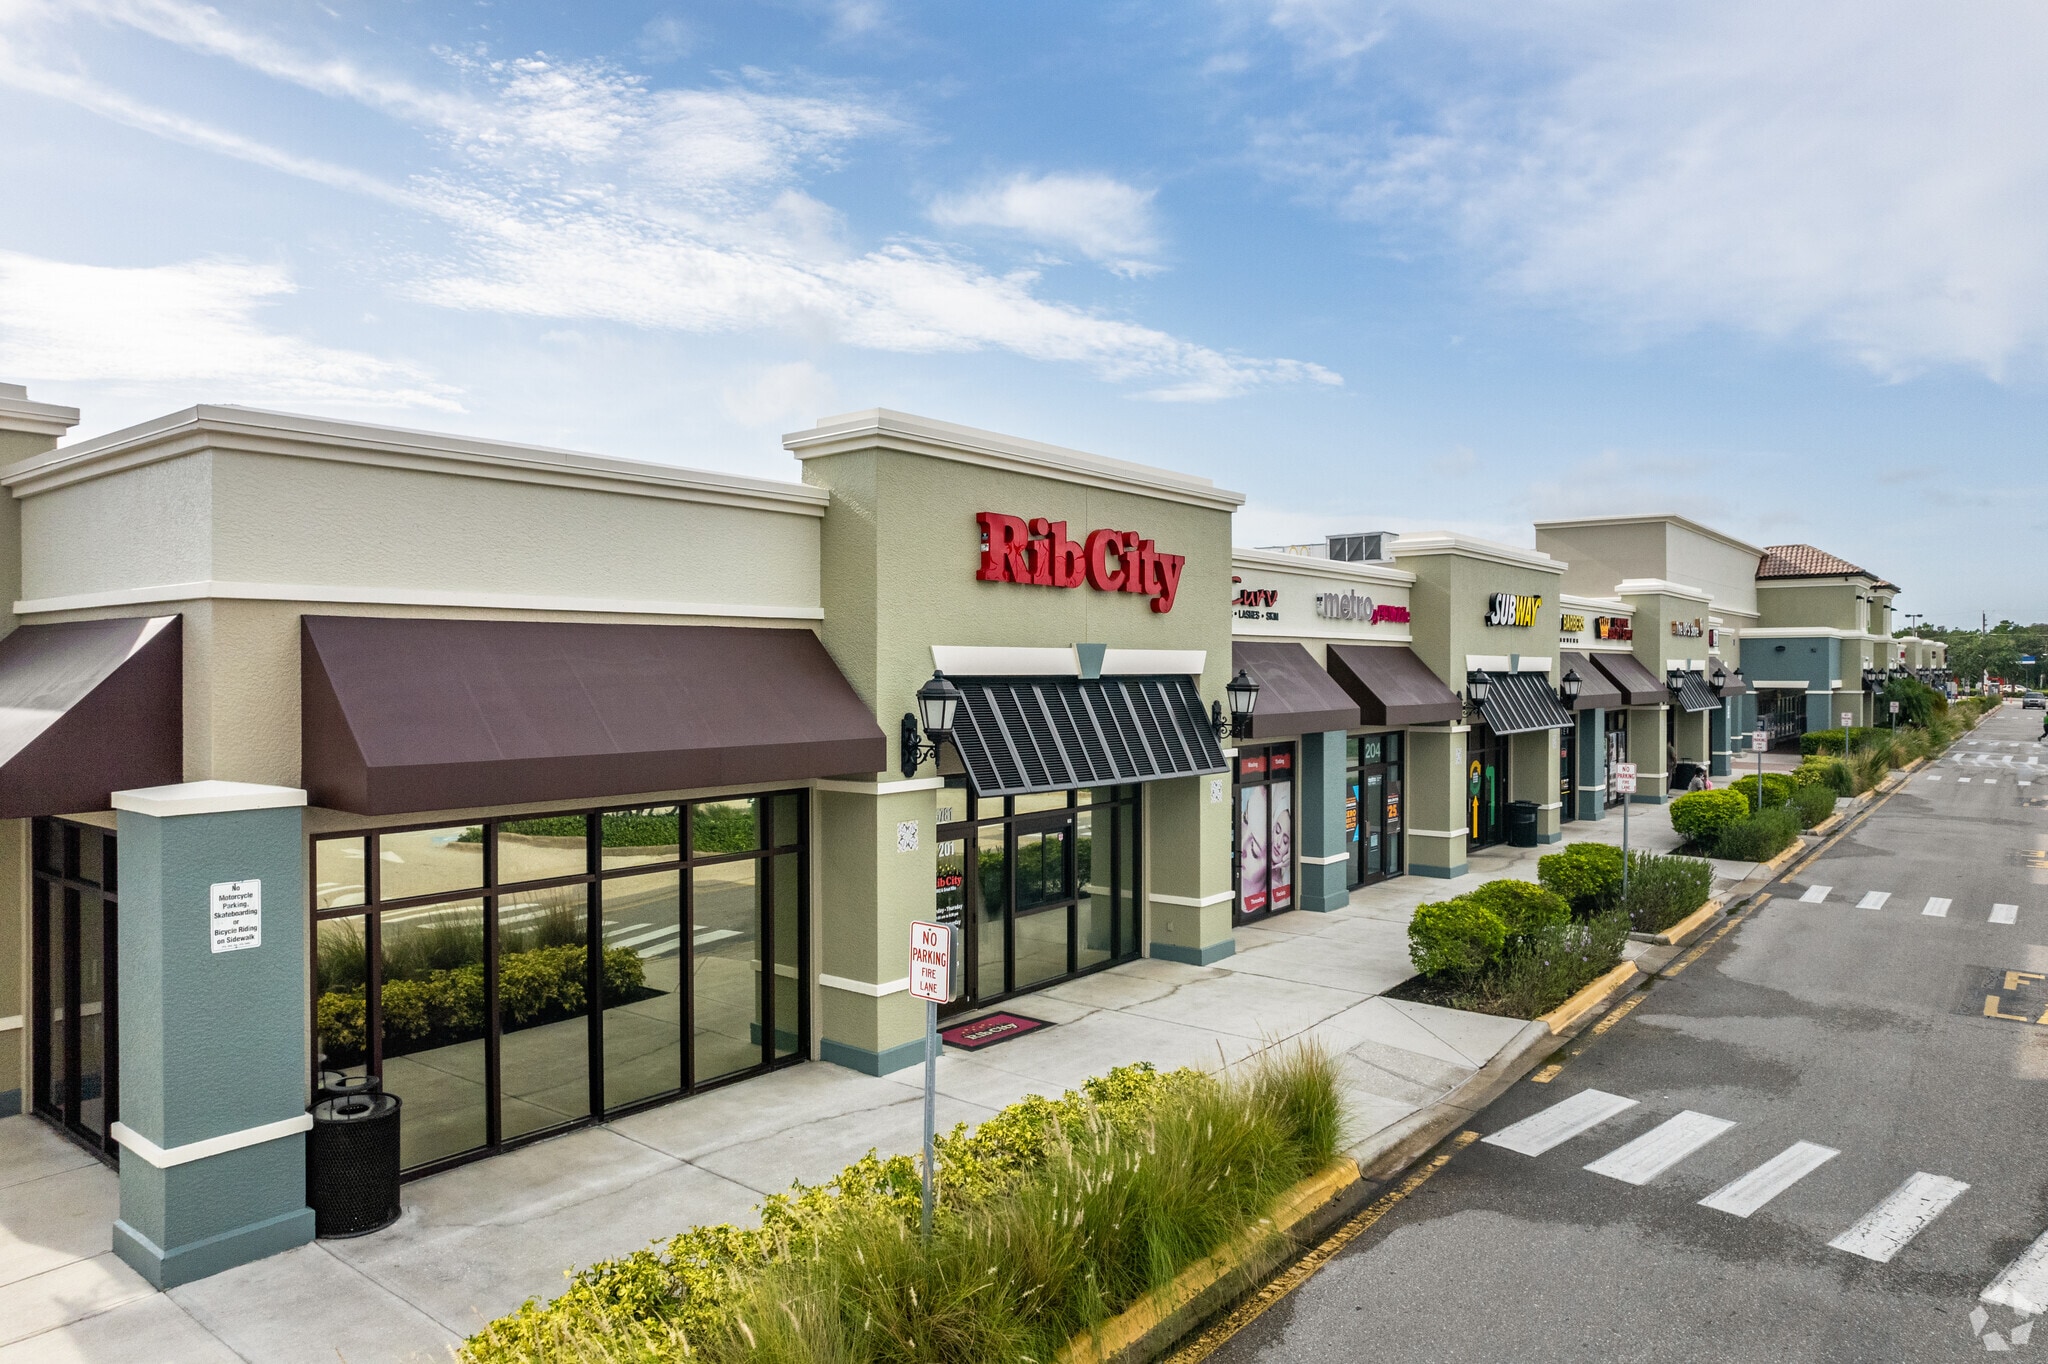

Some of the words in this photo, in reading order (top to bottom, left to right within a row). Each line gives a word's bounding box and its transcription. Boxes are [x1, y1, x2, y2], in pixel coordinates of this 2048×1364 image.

[1323, 589, 1373, 621] metro
[1487, 592, 1542, 627] SUBWAY
[1238, 610, 1260, 619] LASHES
[1365, 742, 1381, 759] 204
[938, 841, 955, 857] 201
[219, 892, 253, 902] Motorcycle
[214, 909, 258, 919] Skateboarding
[214, 927, 238, 936] Bicycle
[238, 925, 258, 934] Riding
[226, 934, 255, 943] Sidewalk
[922, 931, 937, 947] NO
[912, 947, 947, 968] PARKING
[921, 967, 936, 979] FIRE
[919, 981, 938, 994] LANE
